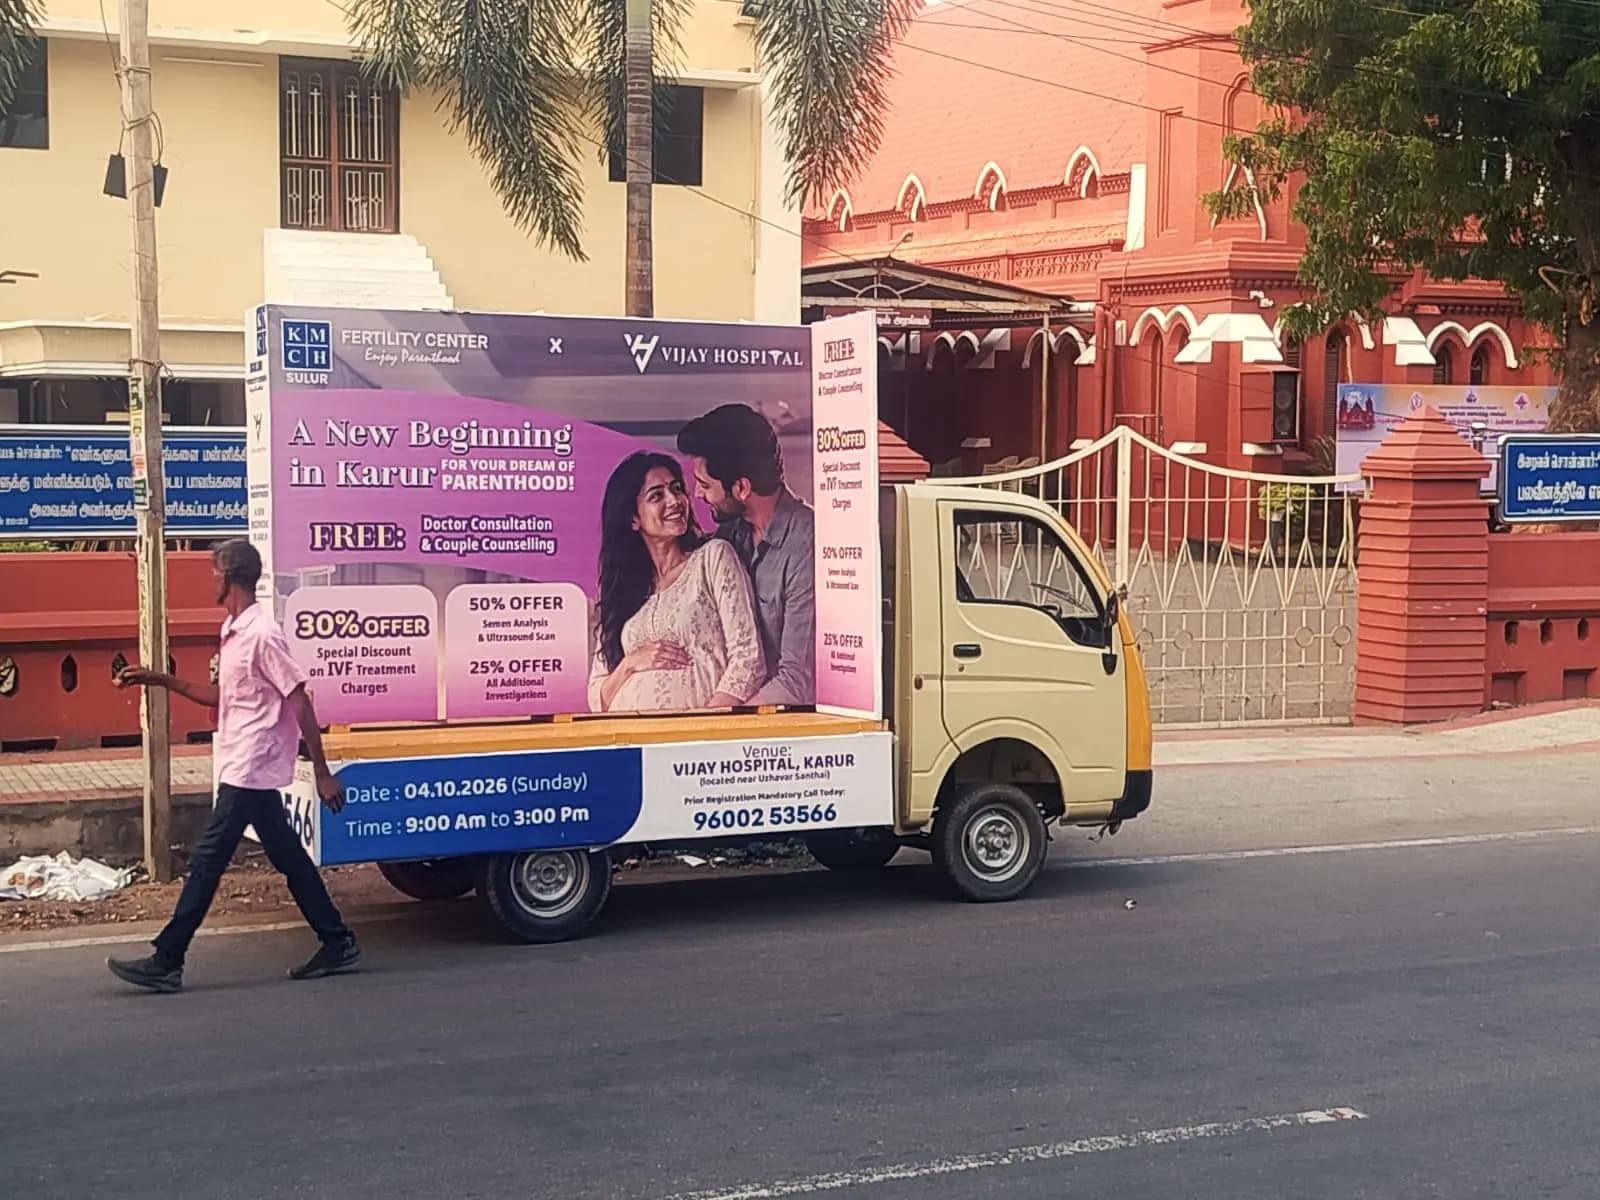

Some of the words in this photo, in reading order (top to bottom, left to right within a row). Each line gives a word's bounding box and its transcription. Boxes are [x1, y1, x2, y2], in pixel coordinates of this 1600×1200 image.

[341, 330, 421, 347] FERTILITY
[425, 332, 489, 349] CENTER
[364, 347, 398, 366] Enjoy
[401, 350, 460, 364] Parenthood
[661, 347, 709, 365] VIJAY
[713, 348, 804, 367] HOSPITAL
[286, 372, 329, 385] SULUR
[288, 418, 315, 446] A
[325, 419, 399, 446] New
[409, 419, 573, 456] Beginning
[817, 427, 840, 452] 30%
[840, 430, 865, 449] OFFER
[290, 458, 326, 487] in
[336, 459, 438, 488] Karur
[441, 459, 467, 471] FOR
[470, 459, 507, 471] YOUR
[510, 460, 555, 472] DREAM
[558, 460, 576, 472] OF
[442, 474, 575, 491] PARENTHOOD!
[422, 515, 469, 532] Doctor
[470, 515, 553, 532] Consultation
[310, 523, 405, 550] FREE:
[421, 537, 432, 551] &
[434, 537, 479, 555] Couple
[481, 537, 556, 554] Counselling
[823, 546, 838, 560] 50%
[839, 547, 863, 560] OFFER
[469, 597, 506, 611] 50%
[509, 596, 563, 610] OFFER
[298, 612, 359, 638] 30%
[363, 617, 429, 637] OFFER
[482, 619, 511, 629] Semen
[513, 618, 549, 631] Analysis
[478, 632, 485, 642] &
[486, 632, 534, 642] Ultrasound
[535, 631, 556, 641] Scan
[823, 632, 839, 647] 25%
[839, 634, 863, 649] OFFER
[317, 647, 358, 660] Special
[361, 645, 411, 658] Discount
[309, 667, 325, 678] on
[327, 662, 353, 677] IVF
[356, 663, 416, 676] Treatment
[469, 660, 505, 674] 25%
[508, 658, 563, 673] OFFER
[341, 681, 388, 697] Charges
[486, 678, 499, 688] All
[500, 677, 545, 688] Additional
[485, 690, 548, 702] Investigations
[742, 745, 792, 759] Venue:
[673, 760, 717, 776] VIJAY
[720, 757, 801, 774] HOSPITAL,
[804, 753, 855, 769] KARUR
[699, 776, 736, 787] (located
[736, 775, 757, 783] near
[758, 772, 793, 783] Uzhavar
[795, 770, 830, 781] Santhai)
[345, 786, 391, 804] Date
[404, 777, 508, 799] 04.10.2026
[511, 772, 588, 794] (Sunday)
[684, 796, 704, 806] Prior
[706, 793, 757, 806] Registration
[758, 791, 802, 802] Mandatory
[804, 789, 819, 798] Call
[820, 788, 846, 799] Today:
[345, 818, 392, 837] Time
[405, 815, 450, 834] 9:00
[454, 812, 487, 831] Am
[491, 811, 510, 827] to
[513, 808, 556, 825] 3:00
[560, 805, 590, 823] Pm
[694, 807, 765, 831] 96002
[769, 803, 837, 824] 53566
